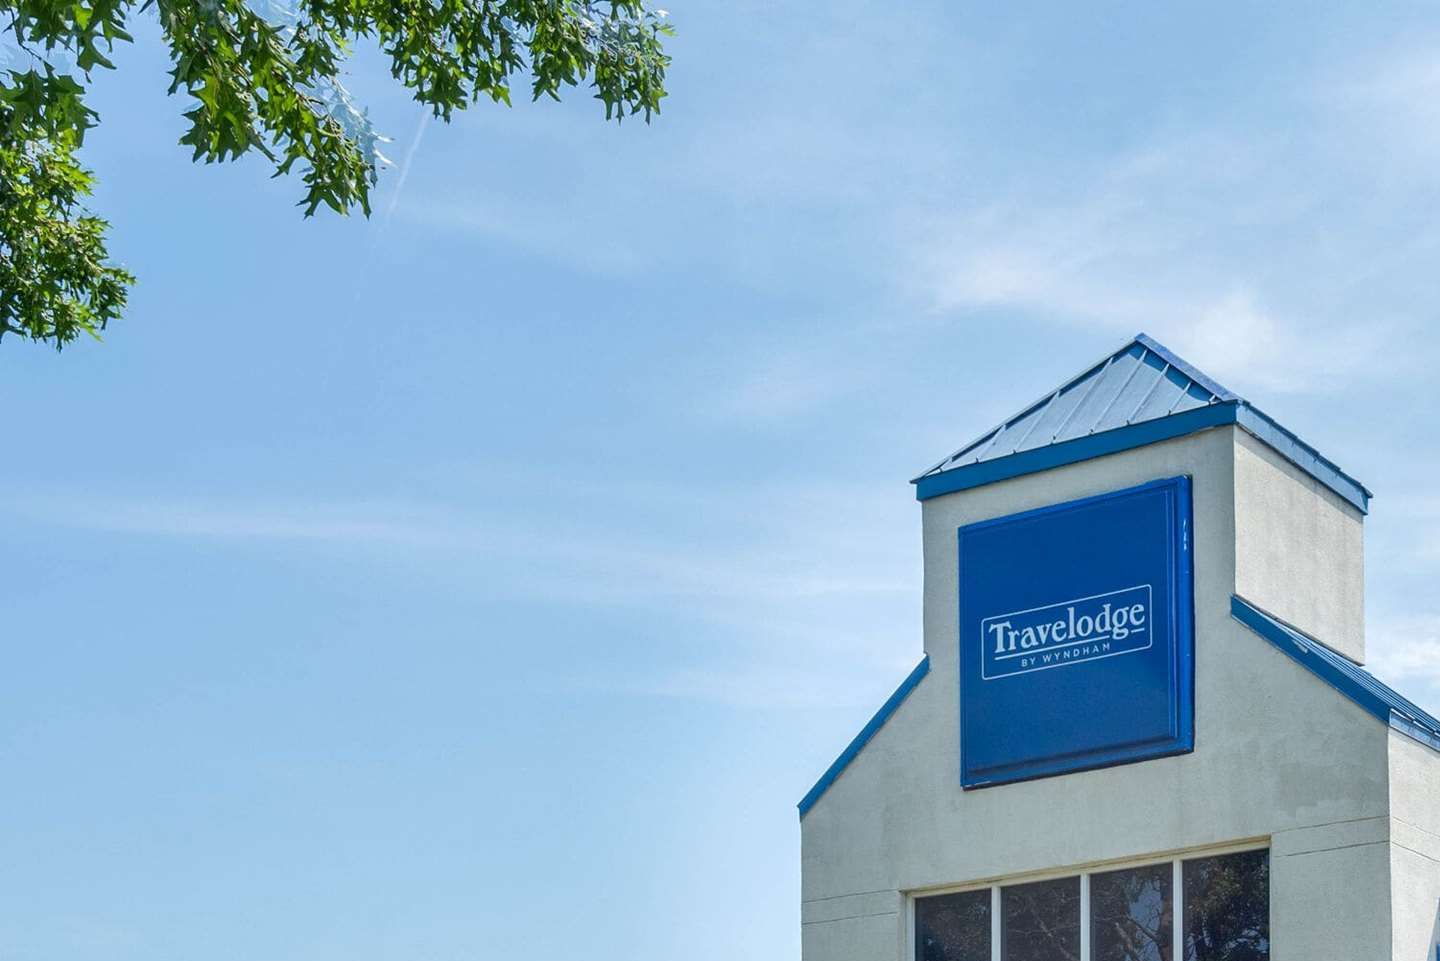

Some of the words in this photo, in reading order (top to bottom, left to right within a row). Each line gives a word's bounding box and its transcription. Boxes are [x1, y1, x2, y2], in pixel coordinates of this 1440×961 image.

[988, 603, 1145, 653] Travelodge
[1021, 657, 1036, 667] BY
[1042, 642, 1111, 663] WYNDHAM
